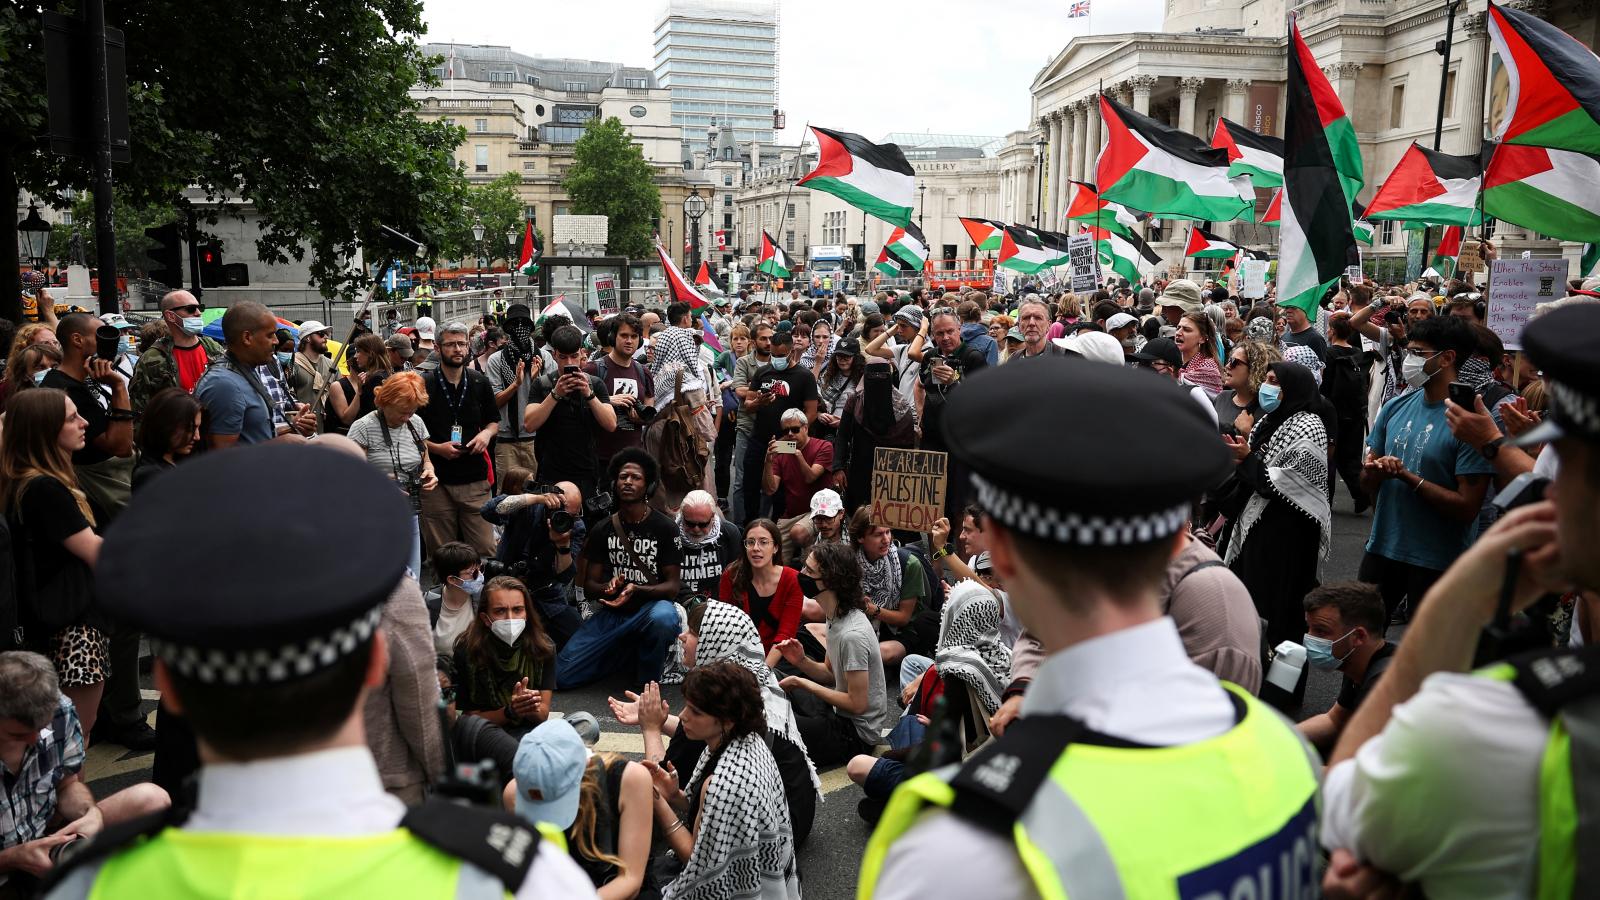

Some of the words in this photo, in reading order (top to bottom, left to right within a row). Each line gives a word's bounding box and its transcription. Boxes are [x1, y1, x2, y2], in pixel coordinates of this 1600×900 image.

[1253, 104, 1262, 133] elasco
[912, 163, 957, 171] ALLERY
[1084, 245, 1093, 256] OFF
[1071, 255, 1093, 267] PALESTINE
[1493, 262, 1516, 274] When
[1521, 262, 1533, 273] The
[1539, 262, 1561, 272] State
[1492, 275, 1524, 287] Enables
[1491, 290, 1529, 300] Genocide
[1491, 303, 1505, 313] We
[1491, 314, 1505, 323] The
[1490, 325, 1516, 337] Trying
[874, 450, 893, 472] WE
[896, 451, 919, 473] ARE
[921, 452, 944, 475] ALL
[874, 473, 942, 506] PALESTINE
[873, 500, 939, 531] ACTION
[630, 538, 658, 557] OPS
[681, 550, 718, 568] ITISH
[680, 564, 723, 581] MMER
